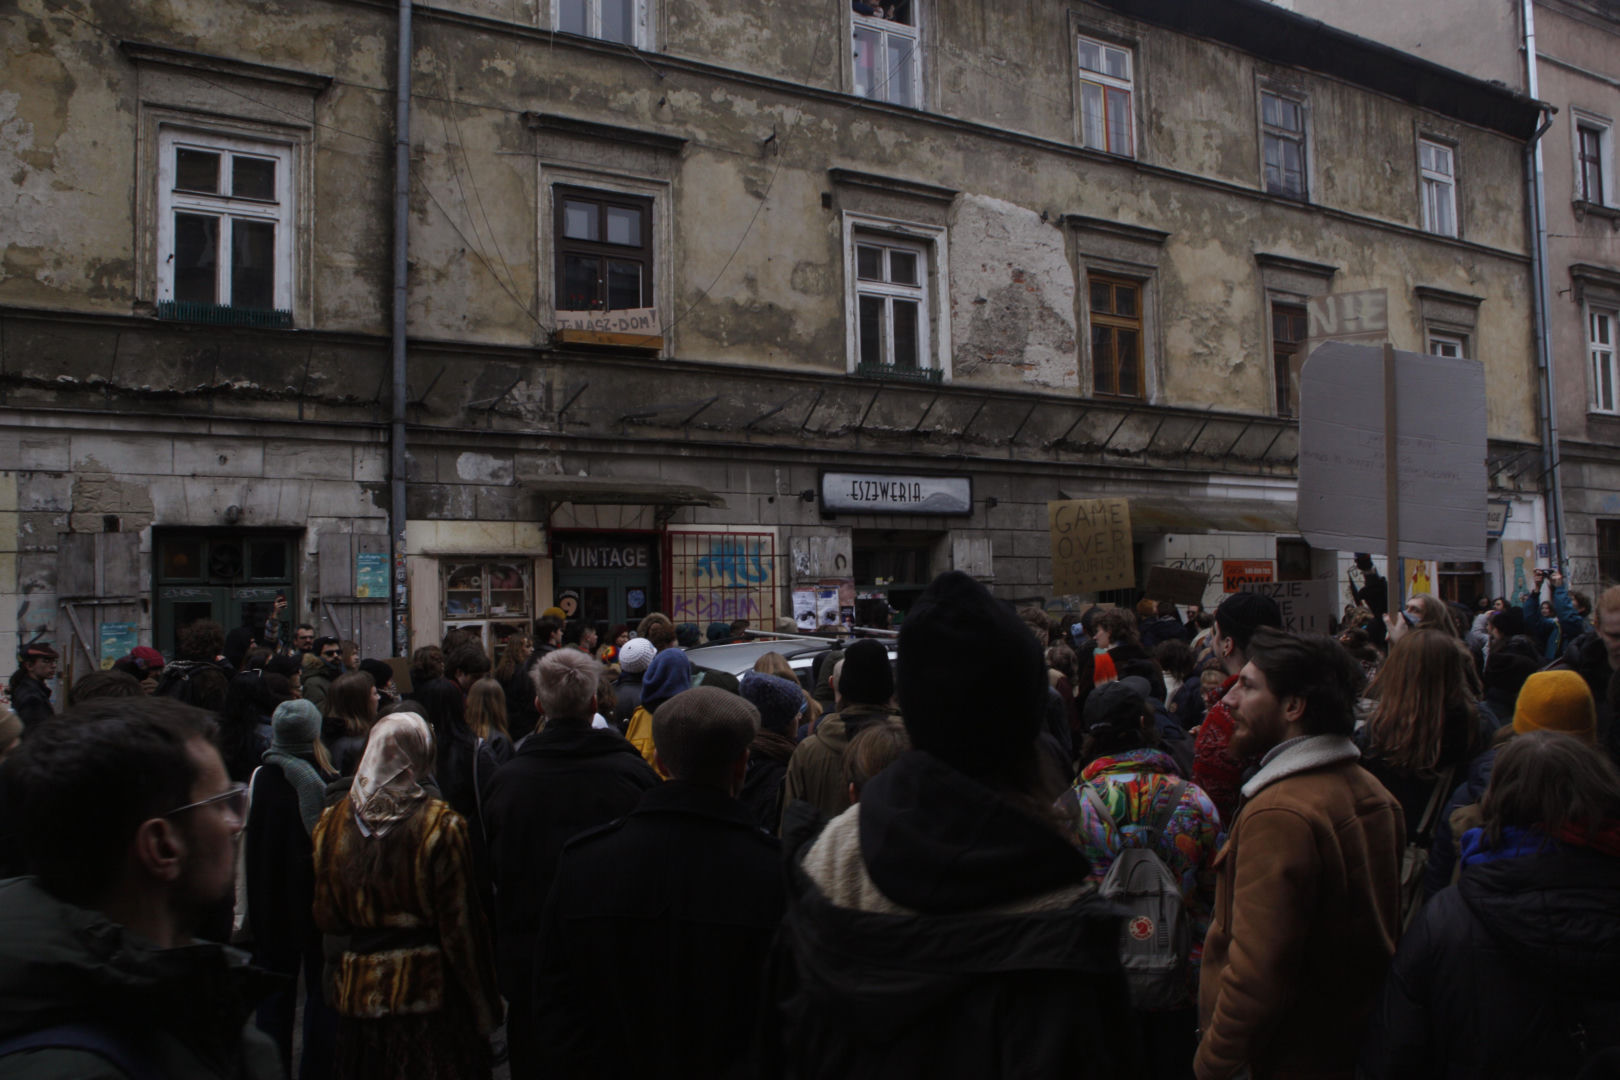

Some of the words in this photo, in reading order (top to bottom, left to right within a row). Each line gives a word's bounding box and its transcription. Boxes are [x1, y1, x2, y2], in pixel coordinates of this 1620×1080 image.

[1055, 503, 1123, 534] GAME
[567, 546, 647, 567] VINTAGE
[1058, 529, 1126, 559] OVER
[1061, 553, 1126, 577] TOURISM
